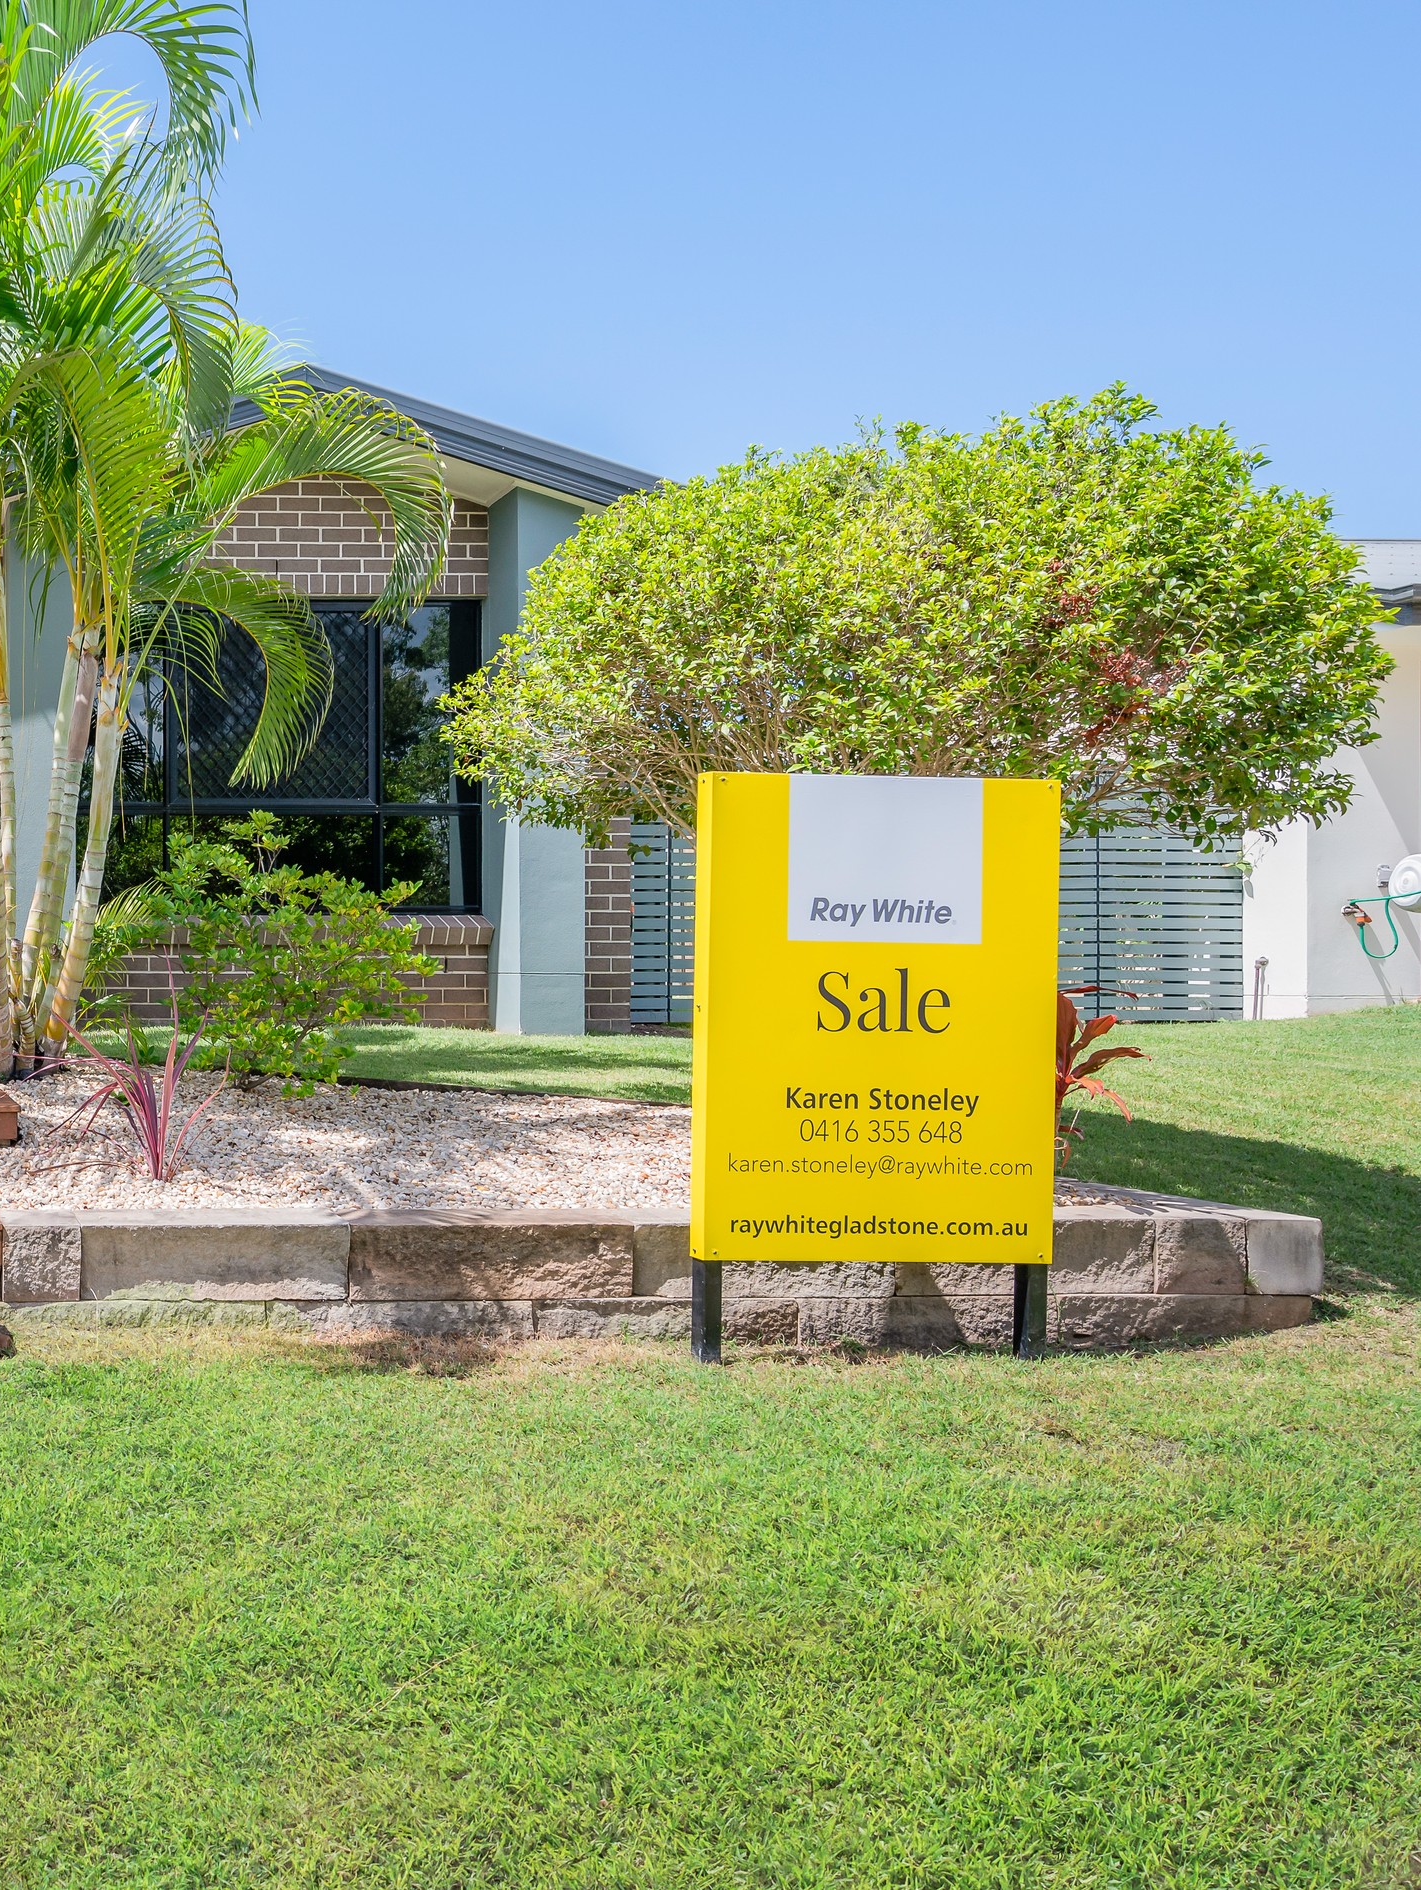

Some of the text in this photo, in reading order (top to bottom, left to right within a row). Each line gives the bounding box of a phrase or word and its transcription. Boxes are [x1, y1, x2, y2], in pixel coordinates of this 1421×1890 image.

[809, 897, 953, 928] Ray White
[816, 967, 951, 1034] Sale
[786, 1086, 980, 1118] Karen Stoneley
[799, 1119, 963, 1145] 0416 355 648
[727, 1153, 1033, 1180] karen.stoneley@raywhite.com
[730, 1215, 1028, 1240] raywhitegladstone.com.au
